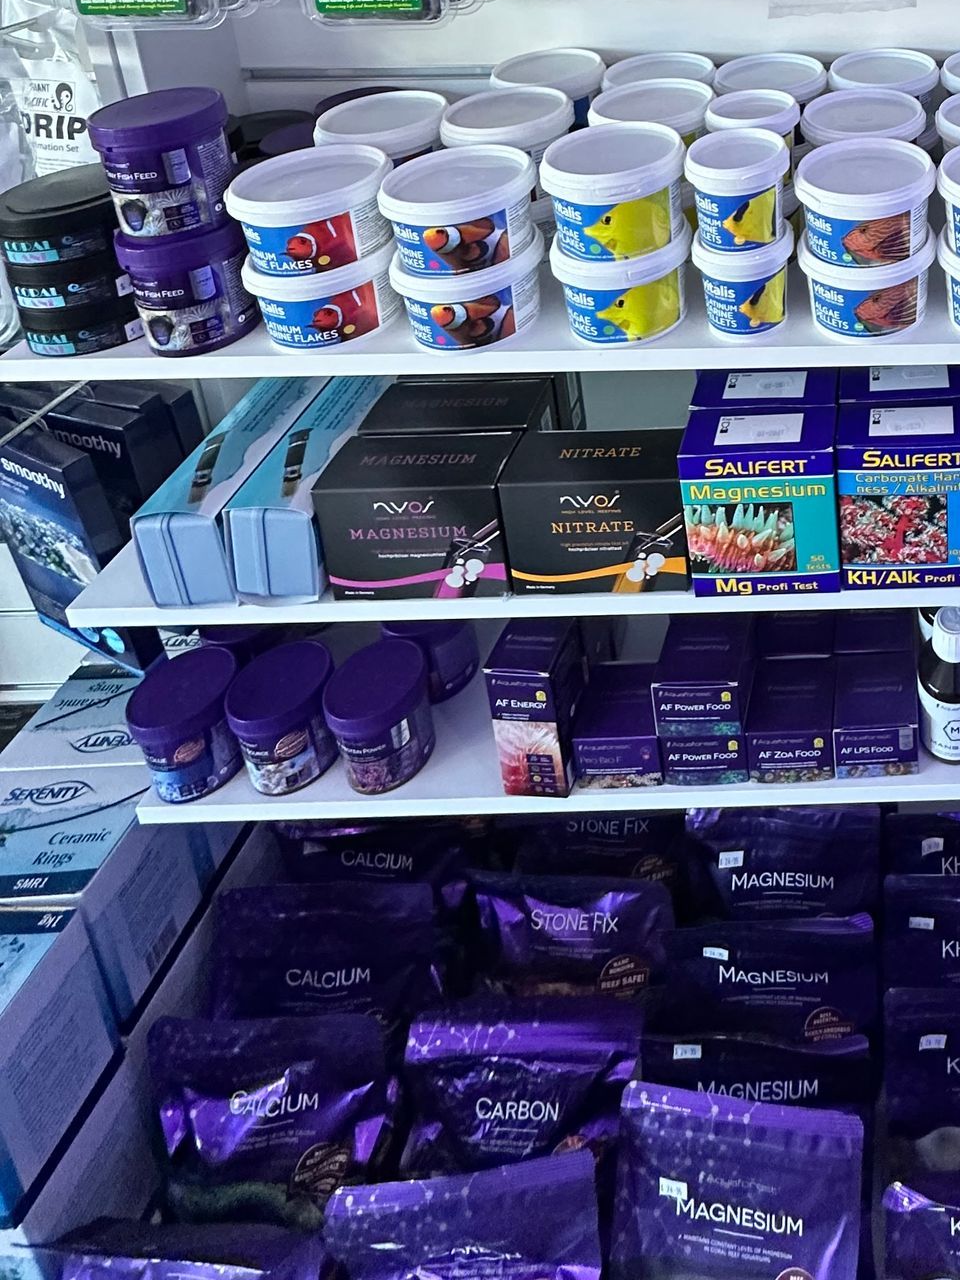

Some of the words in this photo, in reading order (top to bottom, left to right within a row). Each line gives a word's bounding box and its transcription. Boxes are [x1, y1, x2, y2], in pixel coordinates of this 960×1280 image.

[294, 330, 338, 342] FLAKES
[705, 458, 808, 476] SALIFERT
[1, 456, 66, 499] smoothy
[856, 472, 929, 483] Carbonate
[690, 483, 826, 503] Magnesium
[856, 484, 888, 494] ness
[350, 525, 467, 541] MAGNESIUM
[551, 521, 634, 534] NITRATE
[716, 578, 753, 594] Mg
[848, 570, 922, 586] KH/Alk
[925, 574, 955, 583] Profi
[496, 698, 509, 708] AF
[510, 699, 547, 709] ENERGY
[660, 703, 673, 711] AF
[675, 703, 705, 711] POWER
[707, 702, 731, 711] FOOD
[2, 784, 85, 802] SERENITY
[49, 828, 112, 846] Ceramic
[32, 850, 75, 868] Rings
[13, 877, 49, 890] SMR1
[731, 872, 835, 891] MAGNESIUM
[531, 909, 589, 933] STONE
[592, 911, 618, 934] FIX
[286, 968, 371, 989] CALCIUM
[229, 1090, 318, 1118] CALCIUM
[475, 1097, 560, 1121] CARBON
[675, 1197, 803, 1238] MAGNESIUM
